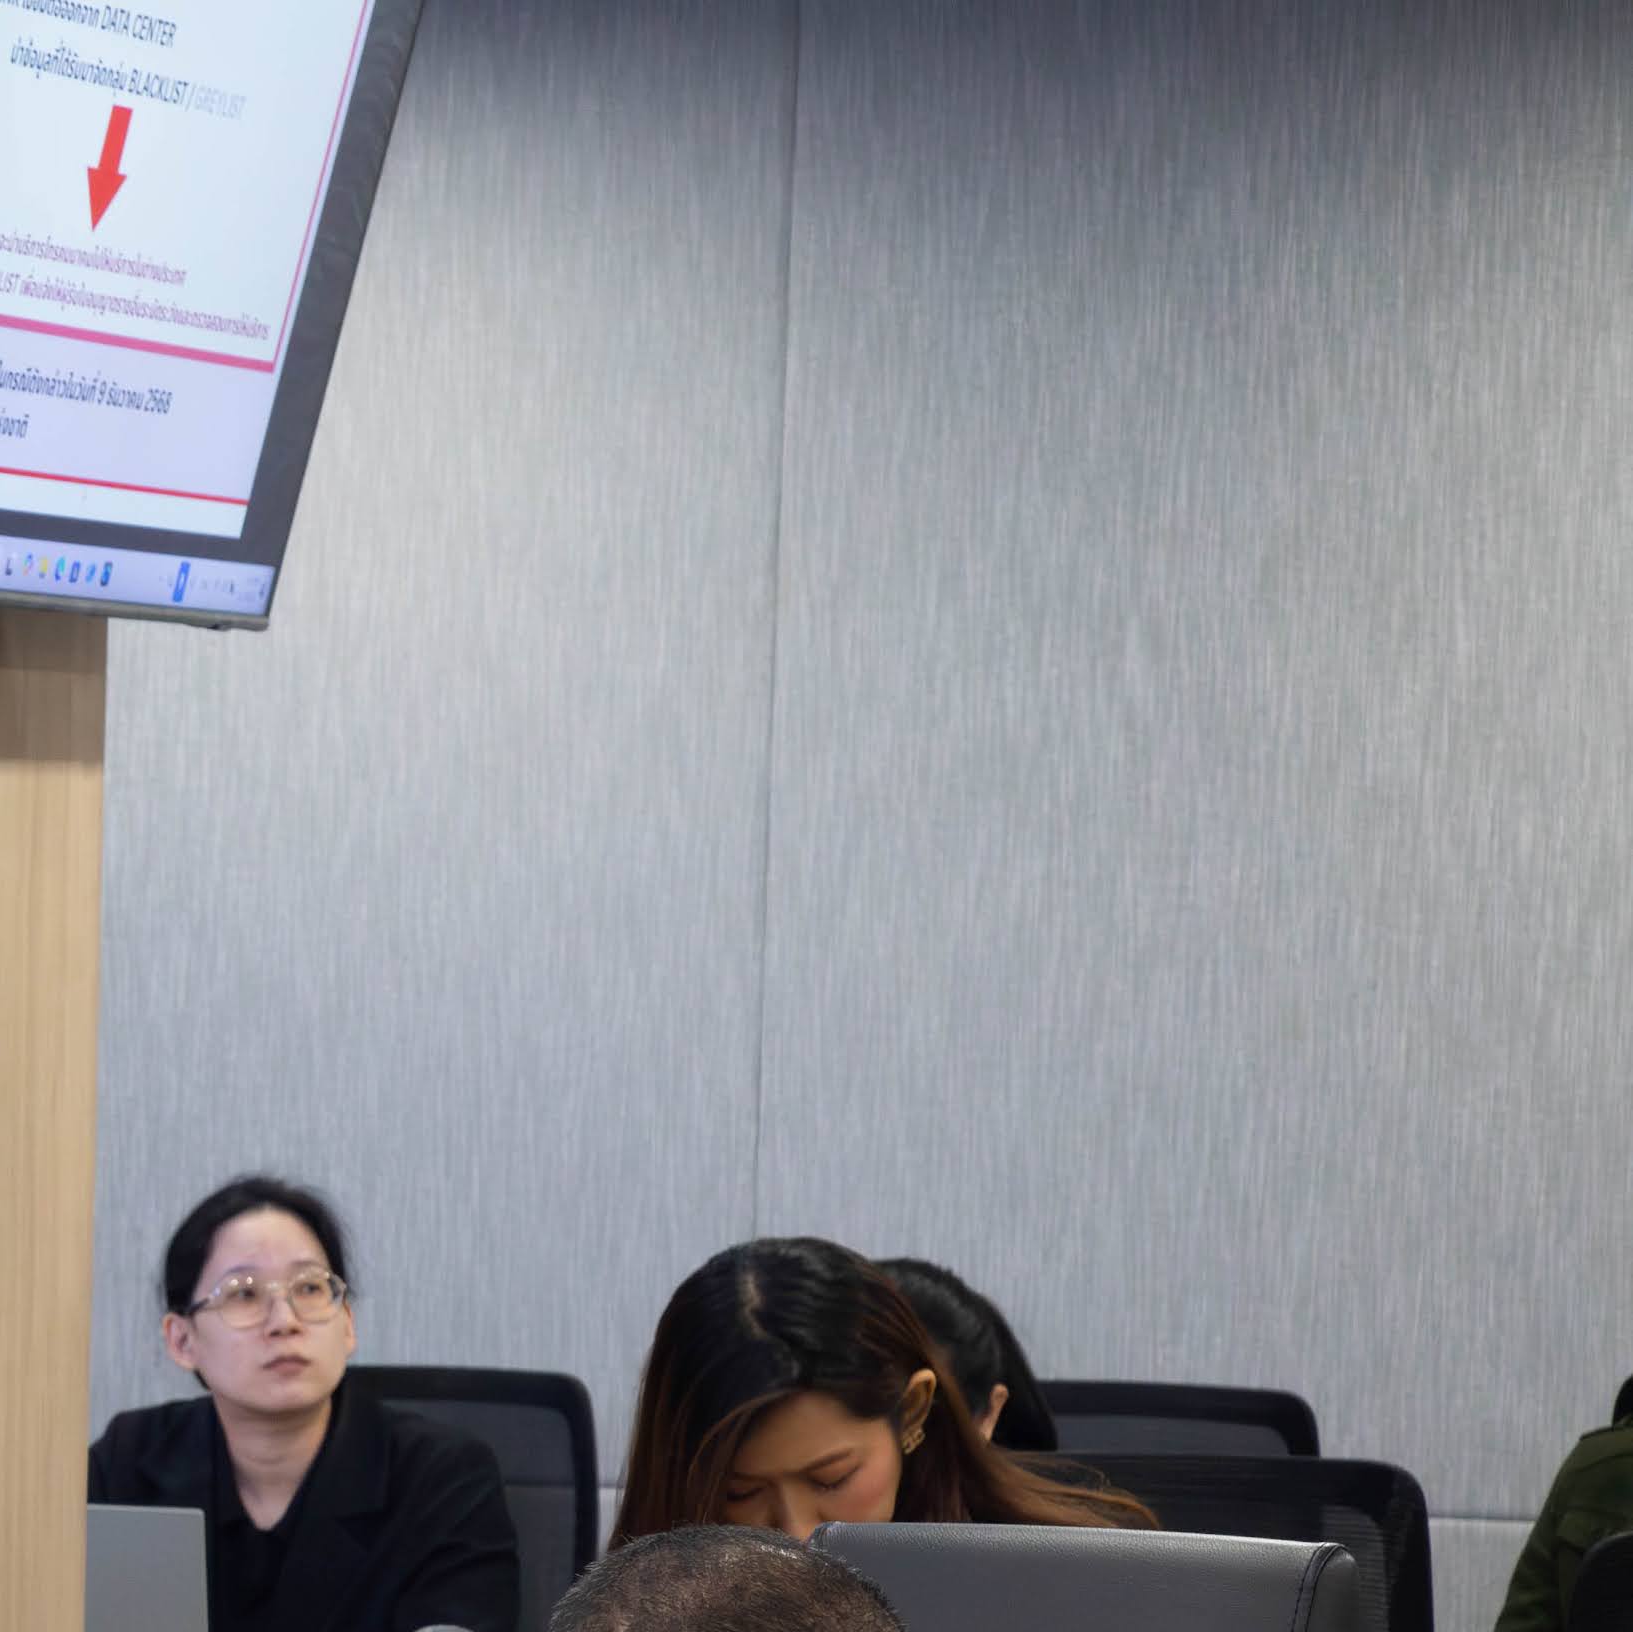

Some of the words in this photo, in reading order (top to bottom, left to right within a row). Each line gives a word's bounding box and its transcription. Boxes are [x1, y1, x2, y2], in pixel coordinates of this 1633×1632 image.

[101, 4, 131, 37] DATA
[132, 14, 177, 48] CENTER
[128, 68, 190, 106] BLACKLIST
[97, 380, 108, 406] 9
[143, 388, 174, 415] 2568
